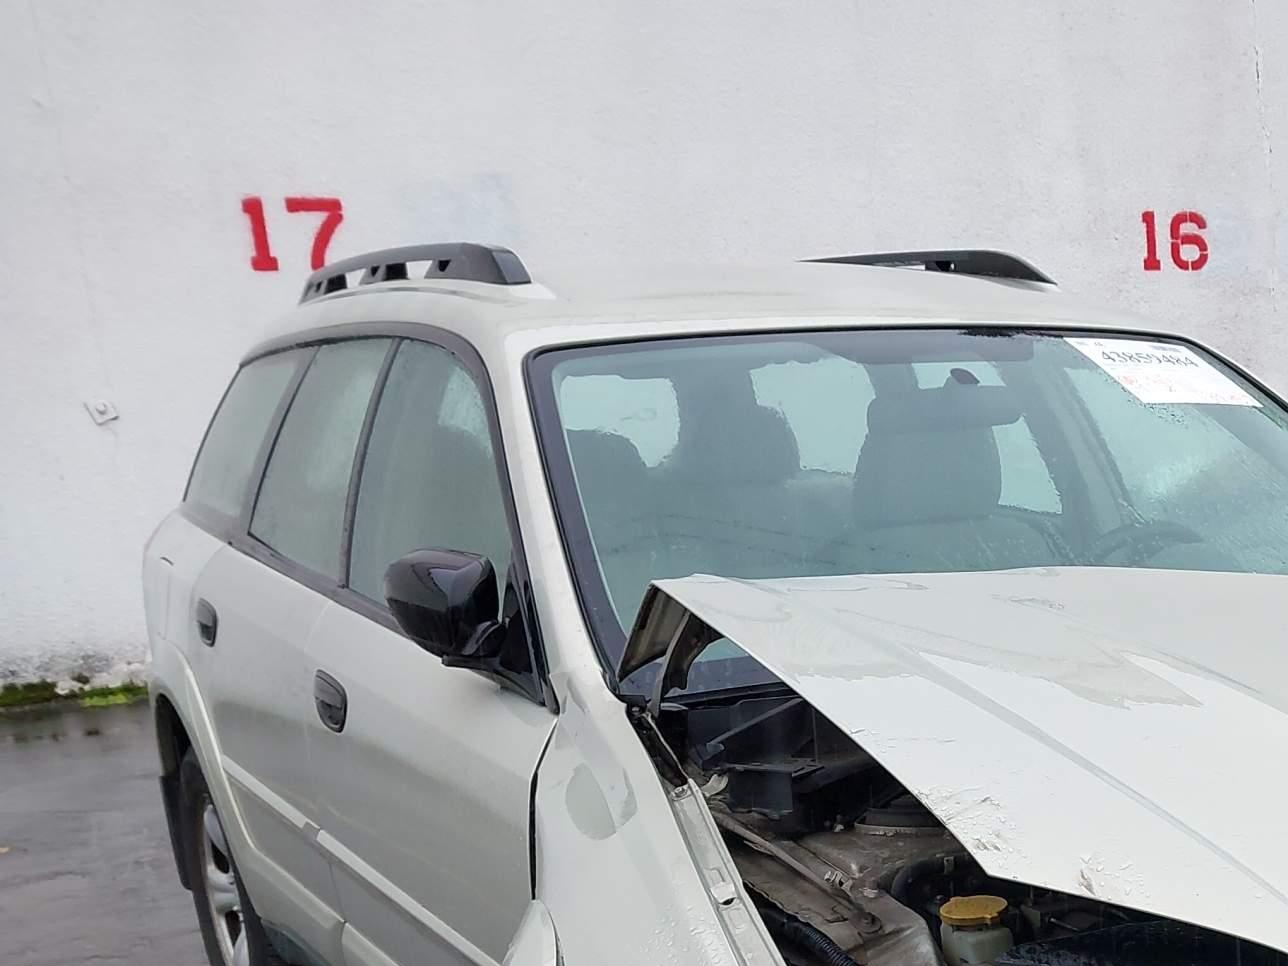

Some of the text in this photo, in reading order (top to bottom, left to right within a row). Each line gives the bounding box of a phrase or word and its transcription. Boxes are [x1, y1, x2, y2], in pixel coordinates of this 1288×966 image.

[241, 197, 343, 273] 17
[1141, 211, 1209, 272] 16
[1101, 350, 1199, 368] 43859484
